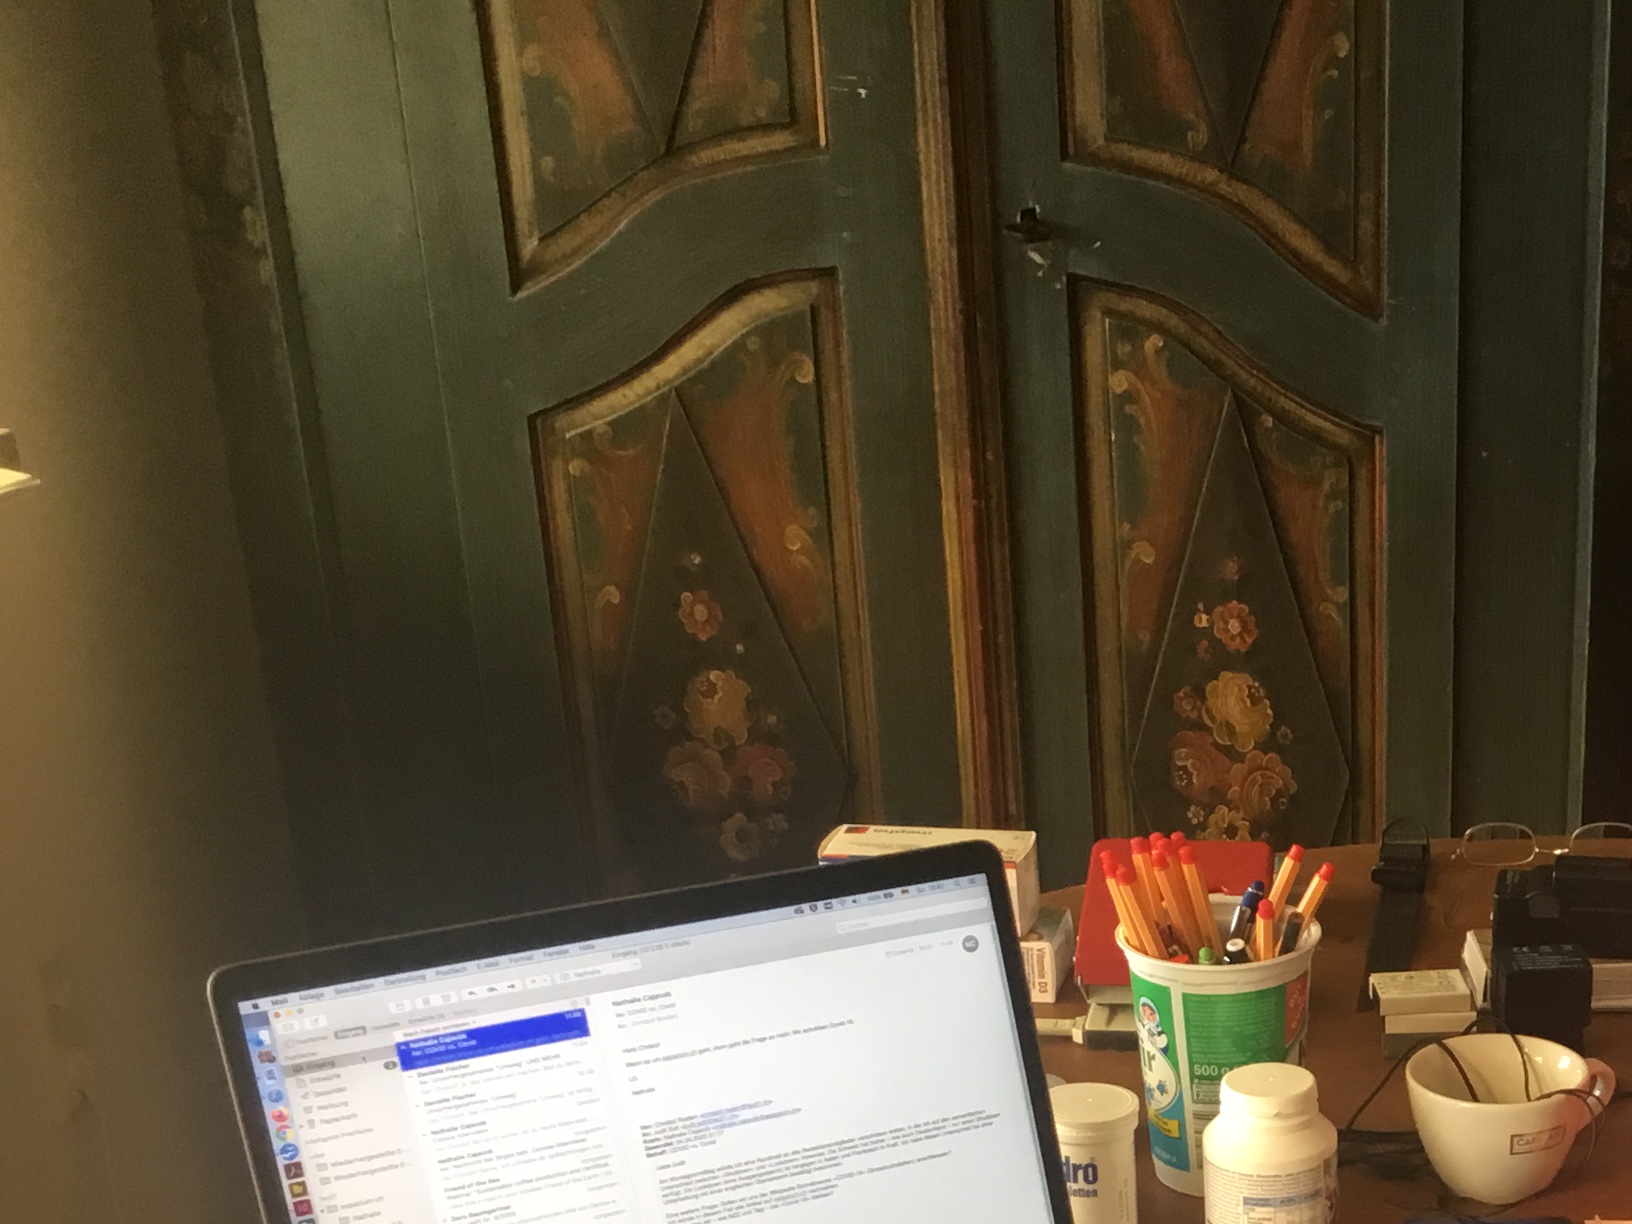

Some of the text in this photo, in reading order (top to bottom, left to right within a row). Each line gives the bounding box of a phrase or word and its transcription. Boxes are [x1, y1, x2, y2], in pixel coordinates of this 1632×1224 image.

[1036, 947, 1048, 994] Vitamin D3
[1193, 1065, 1218, 1076] 500
